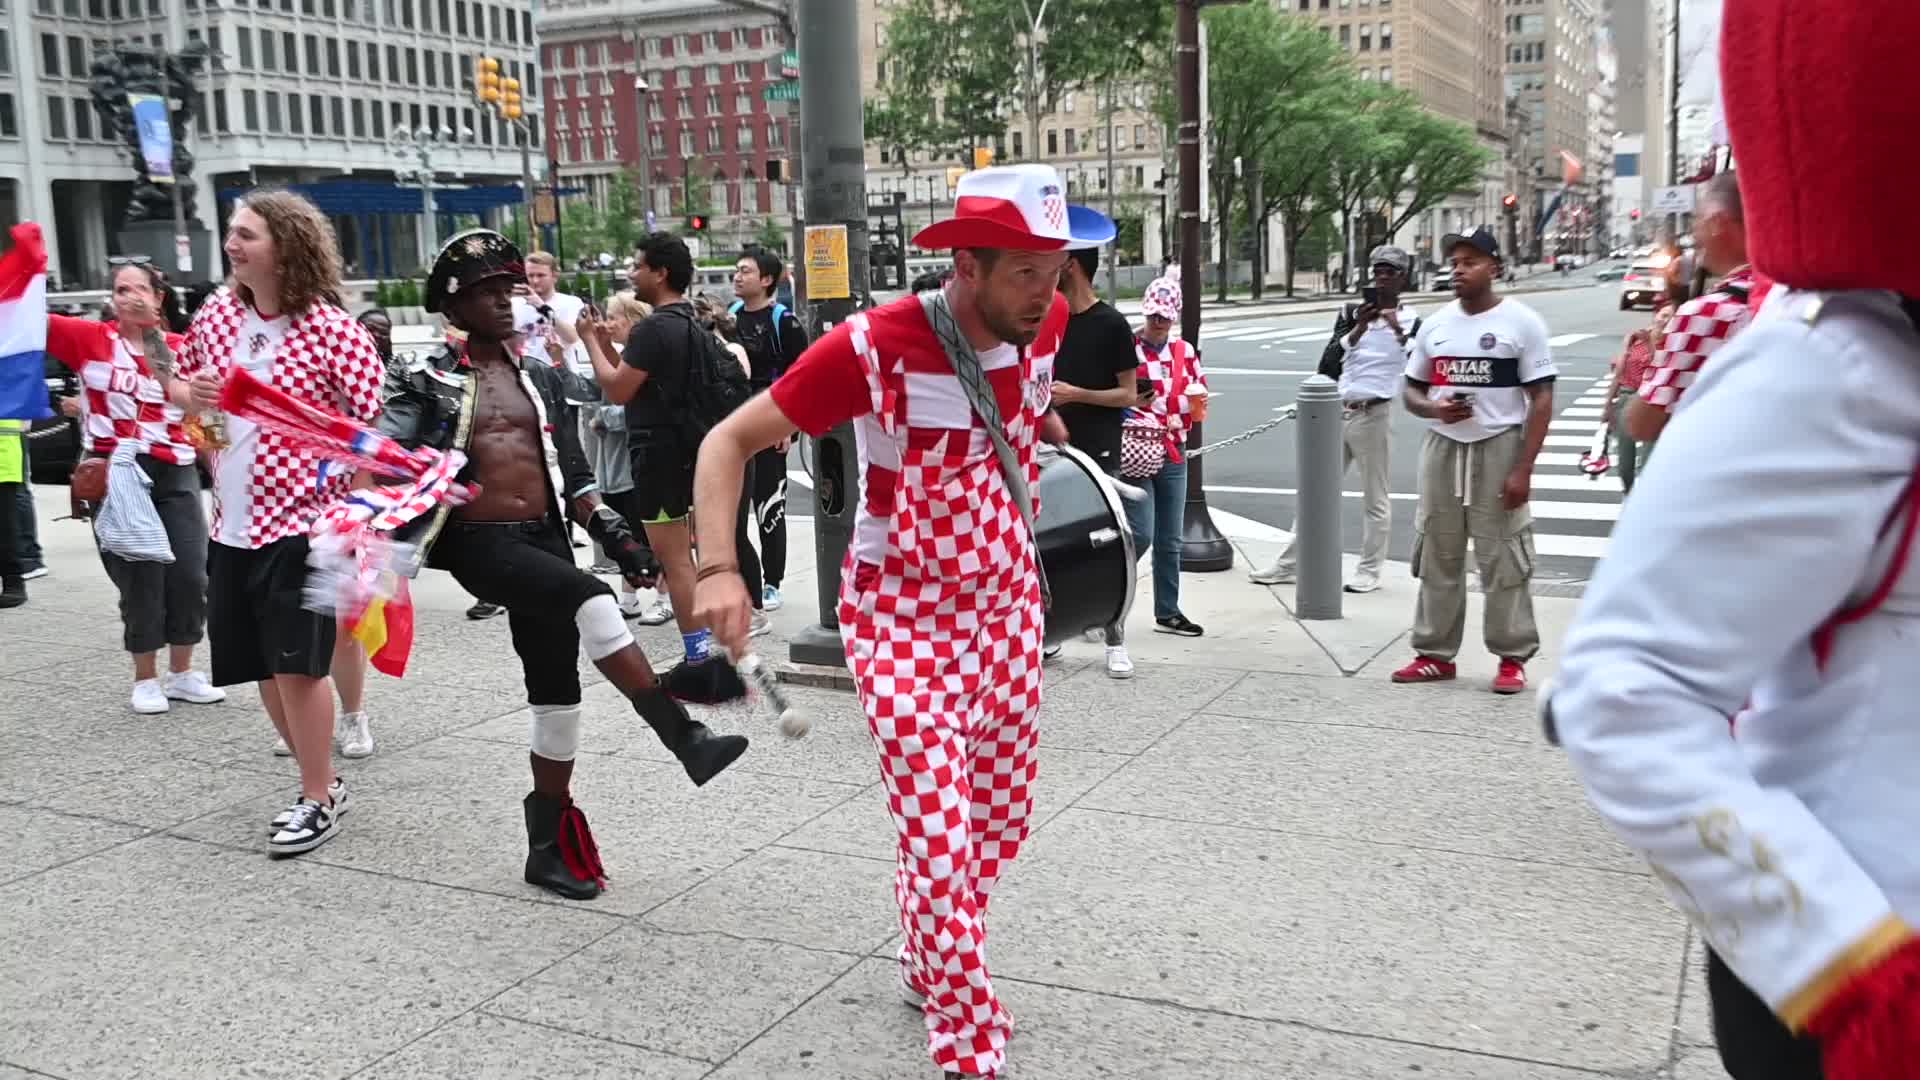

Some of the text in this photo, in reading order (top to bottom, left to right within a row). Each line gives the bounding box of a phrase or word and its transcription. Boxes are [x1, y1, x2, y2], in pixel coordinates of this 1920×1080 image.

[1435, 359, 1492, 376] QATAR
[113, 369, 137, 393] 10
[1446, 374, 1492, 384] AIRWAYS
